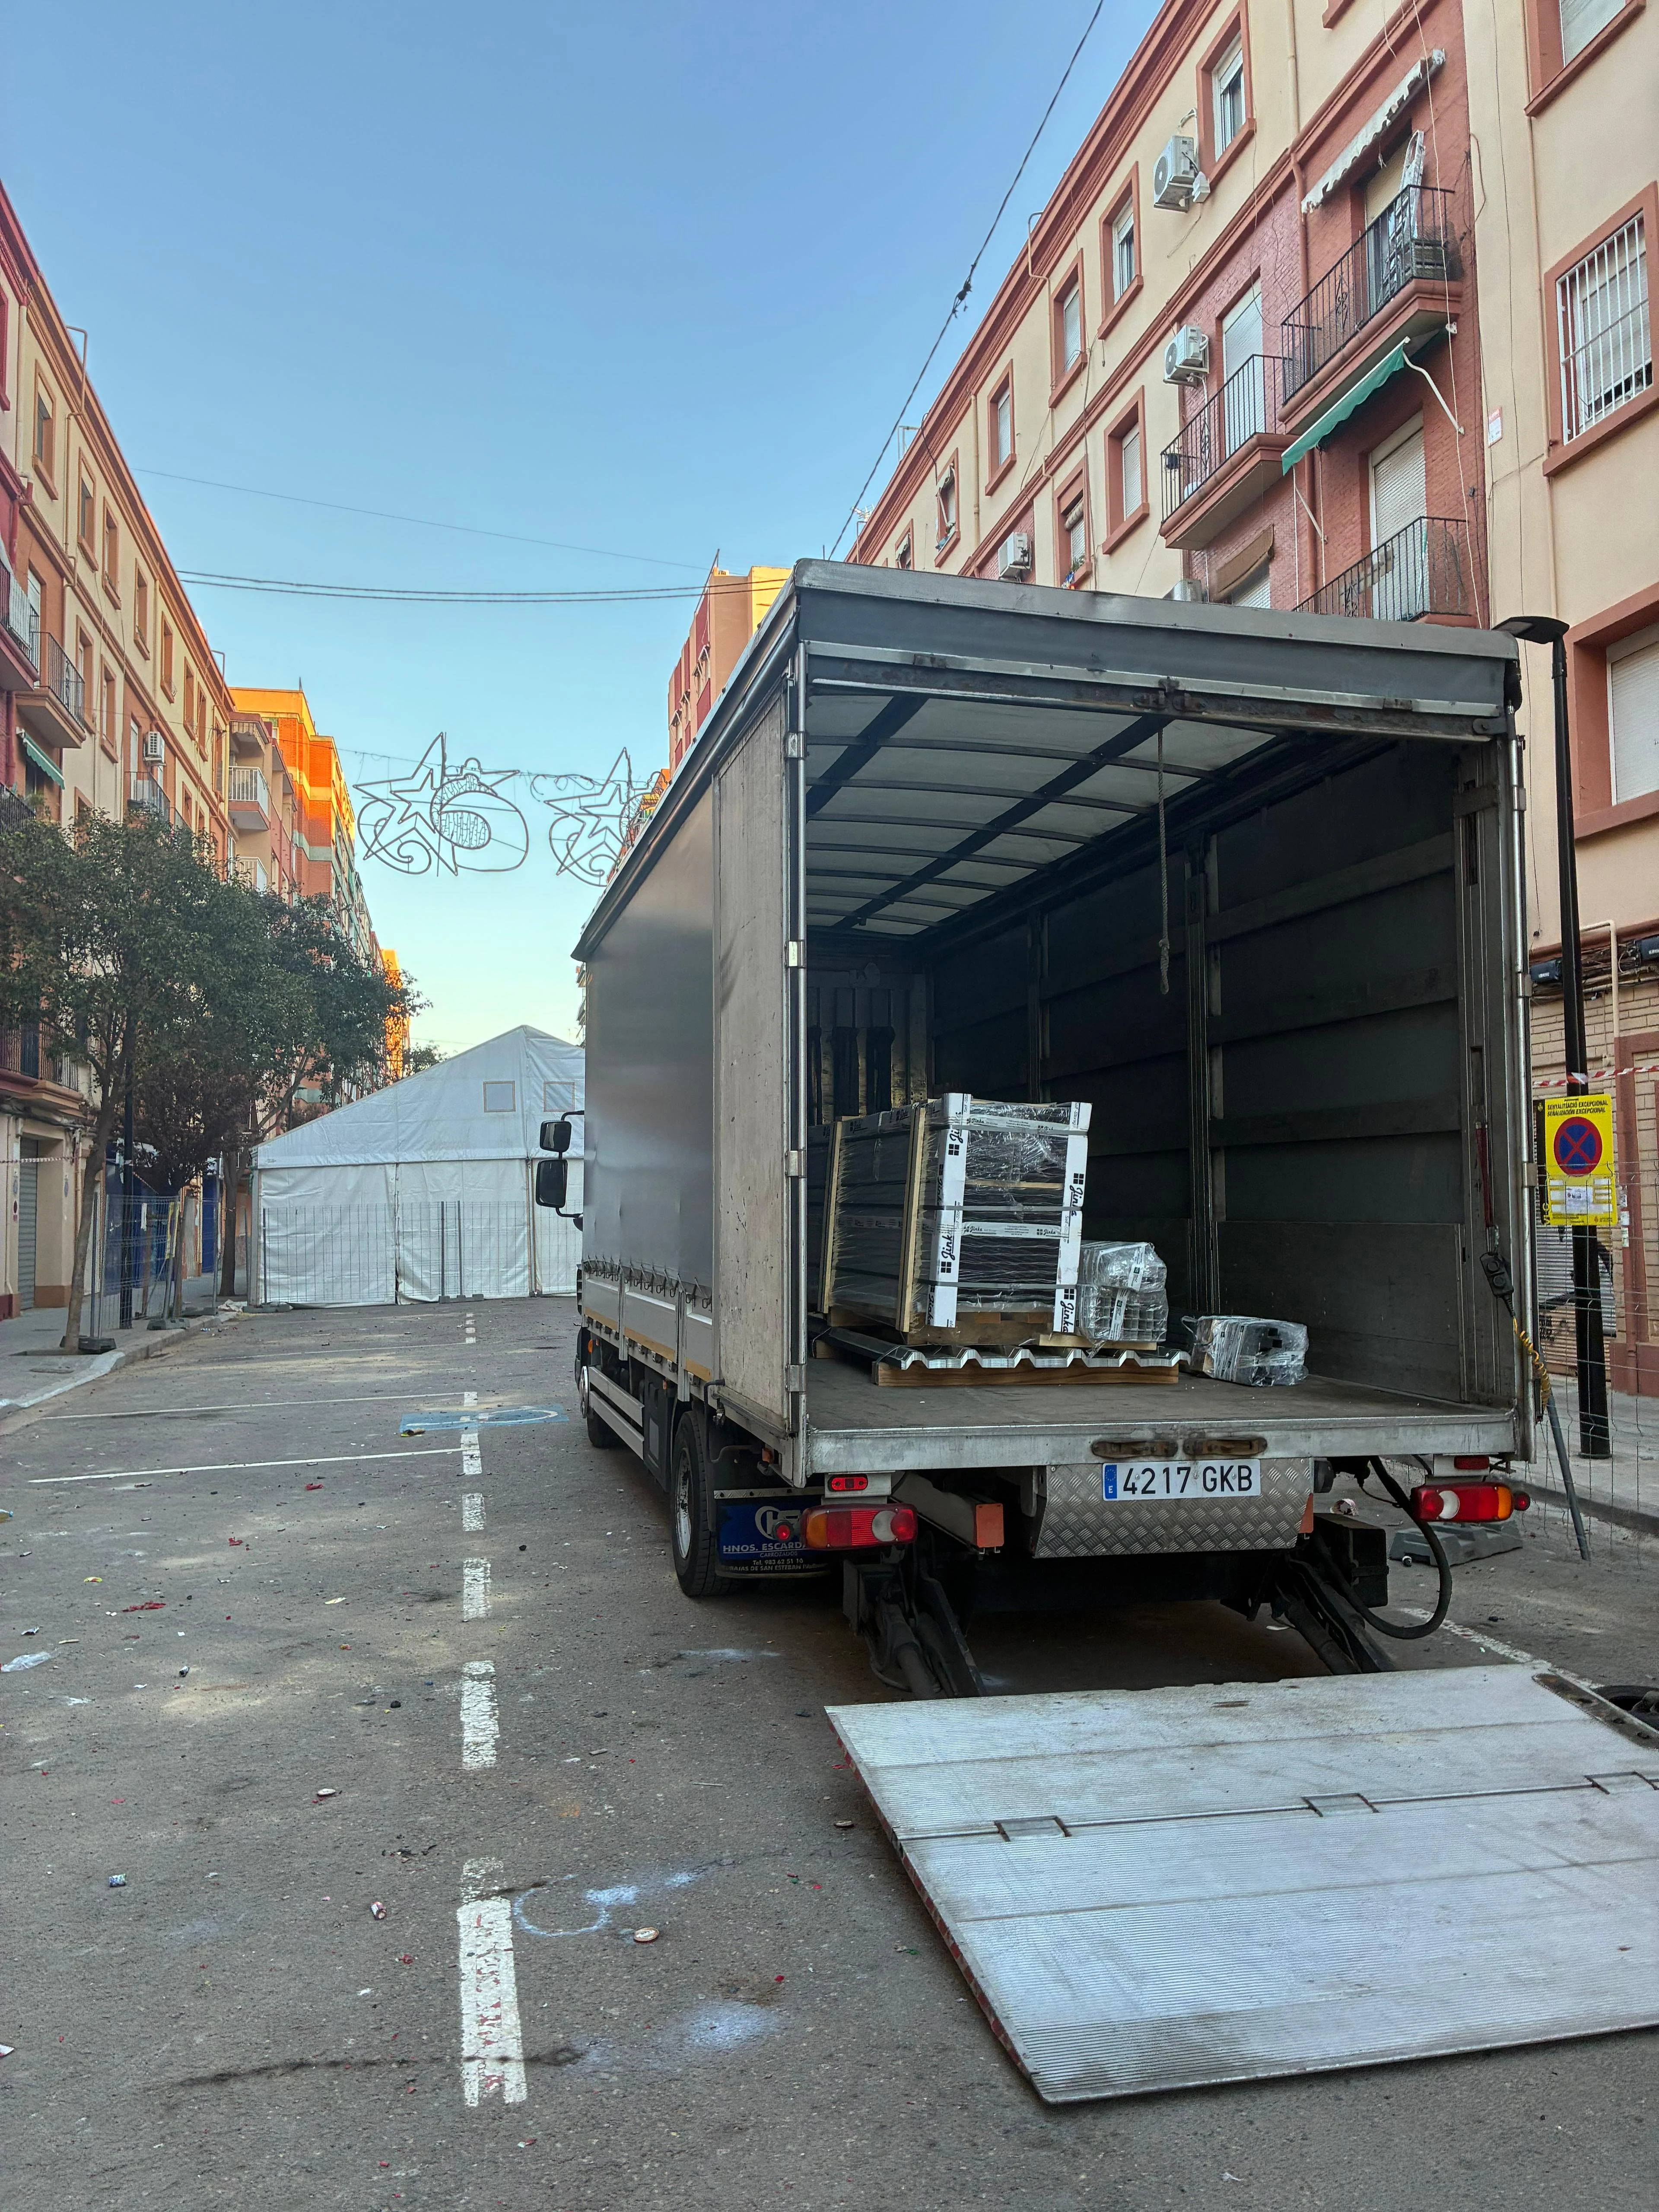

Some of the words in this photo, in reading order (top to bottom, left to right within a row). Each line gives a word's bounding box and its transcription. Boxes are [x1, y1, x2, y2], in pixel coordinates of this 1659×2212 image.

[1069, 1185, 1083, 1217] Jina
[1060, 1300, 1074, 1333] Jinka
[1108, 1485, 1113, 1494] E
[1123, 1467, 1191, 1495] 4217
[1202, 1465, 1252, 1492] GKB
[723, 1544, 759, 1552] HNOS.
